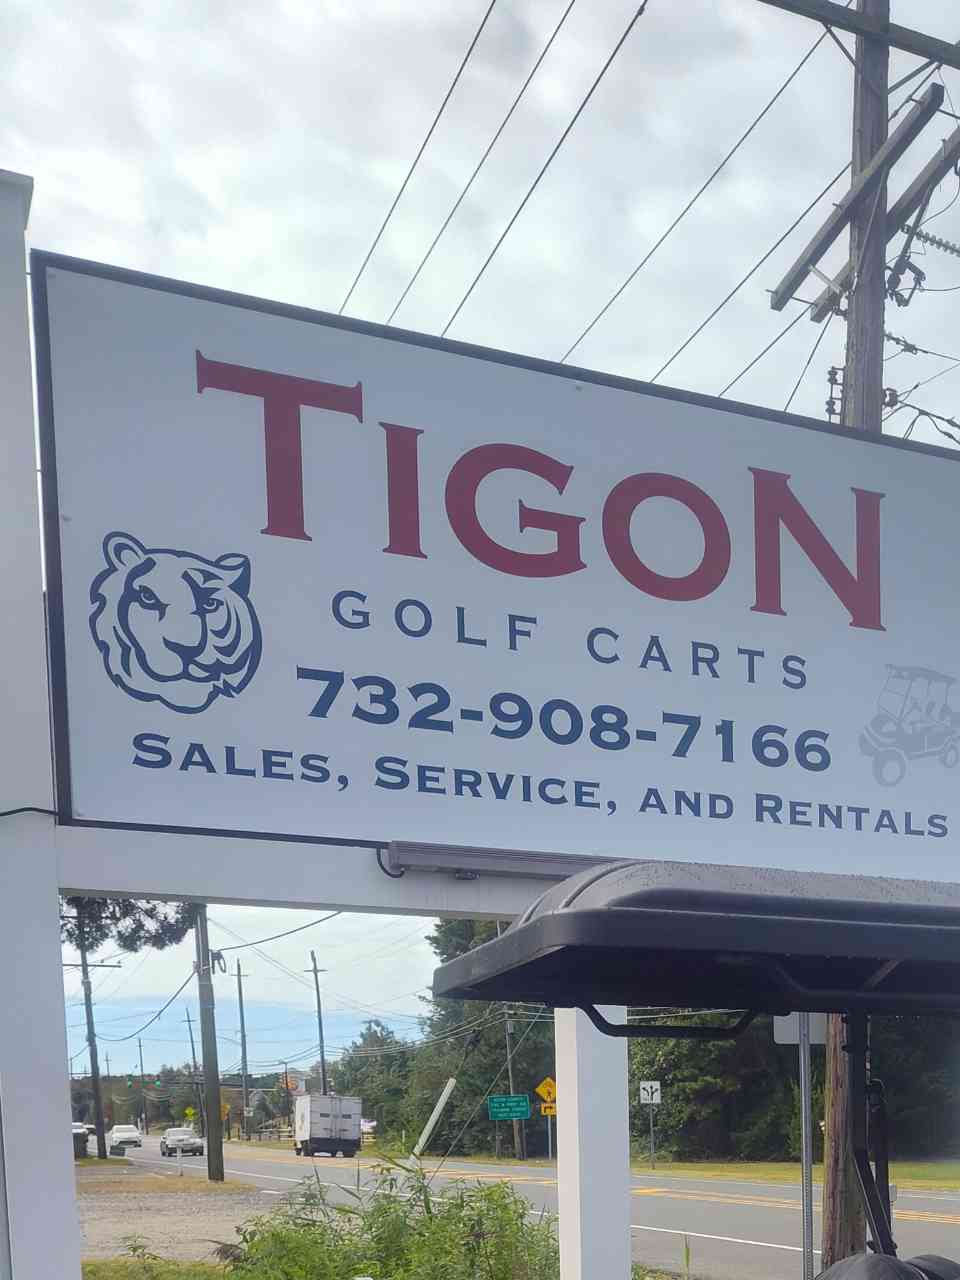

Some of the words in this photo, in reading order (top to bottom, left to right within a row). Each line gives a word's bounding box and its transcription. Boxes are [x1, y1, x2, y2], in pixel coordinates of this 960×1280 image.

[195, 348, 888, 632] TIGON
[331, 589, 539, 652] GOLF
[585, 627, 810, 691] CARTS
[296, 667, 833, 774] 732-908-7166
[132, 733, 350, 794] SALES,
[374, 754, 619, 818] SERVICE,
[639, 787, 734, 821] AND
[753, 792, 951, 840] RENTALS
